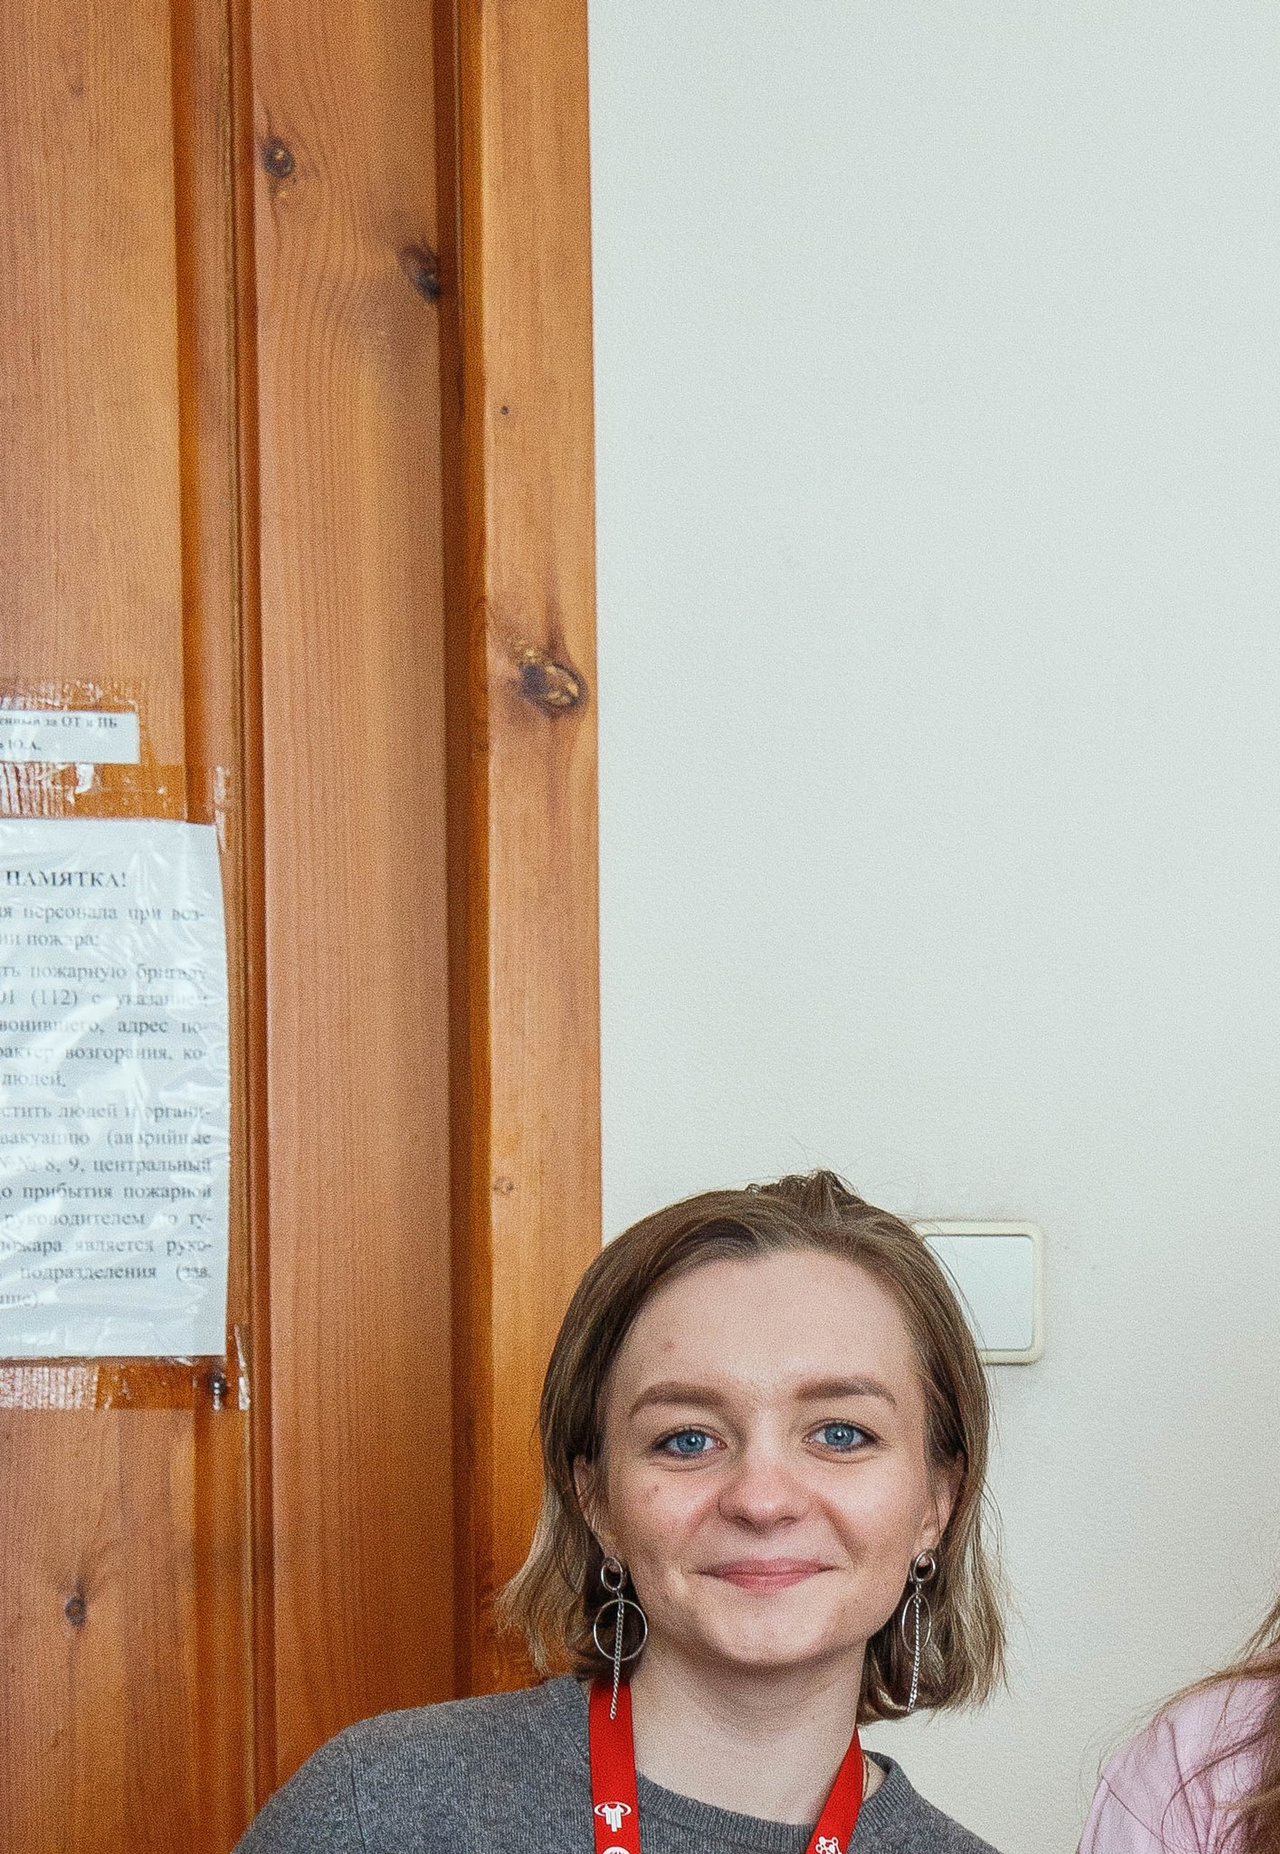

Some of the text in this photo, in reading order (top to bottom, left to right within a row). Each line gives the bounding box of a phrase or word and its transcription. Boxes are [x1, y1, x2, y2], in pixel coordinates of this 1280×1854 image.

[6, 870, 127, 888] ПАМЯТКА!
[30, 966, 127, 982] пожарную
[31, 989, 78, 1007] (112)
[117, 1021, 167, 1036] адрес
